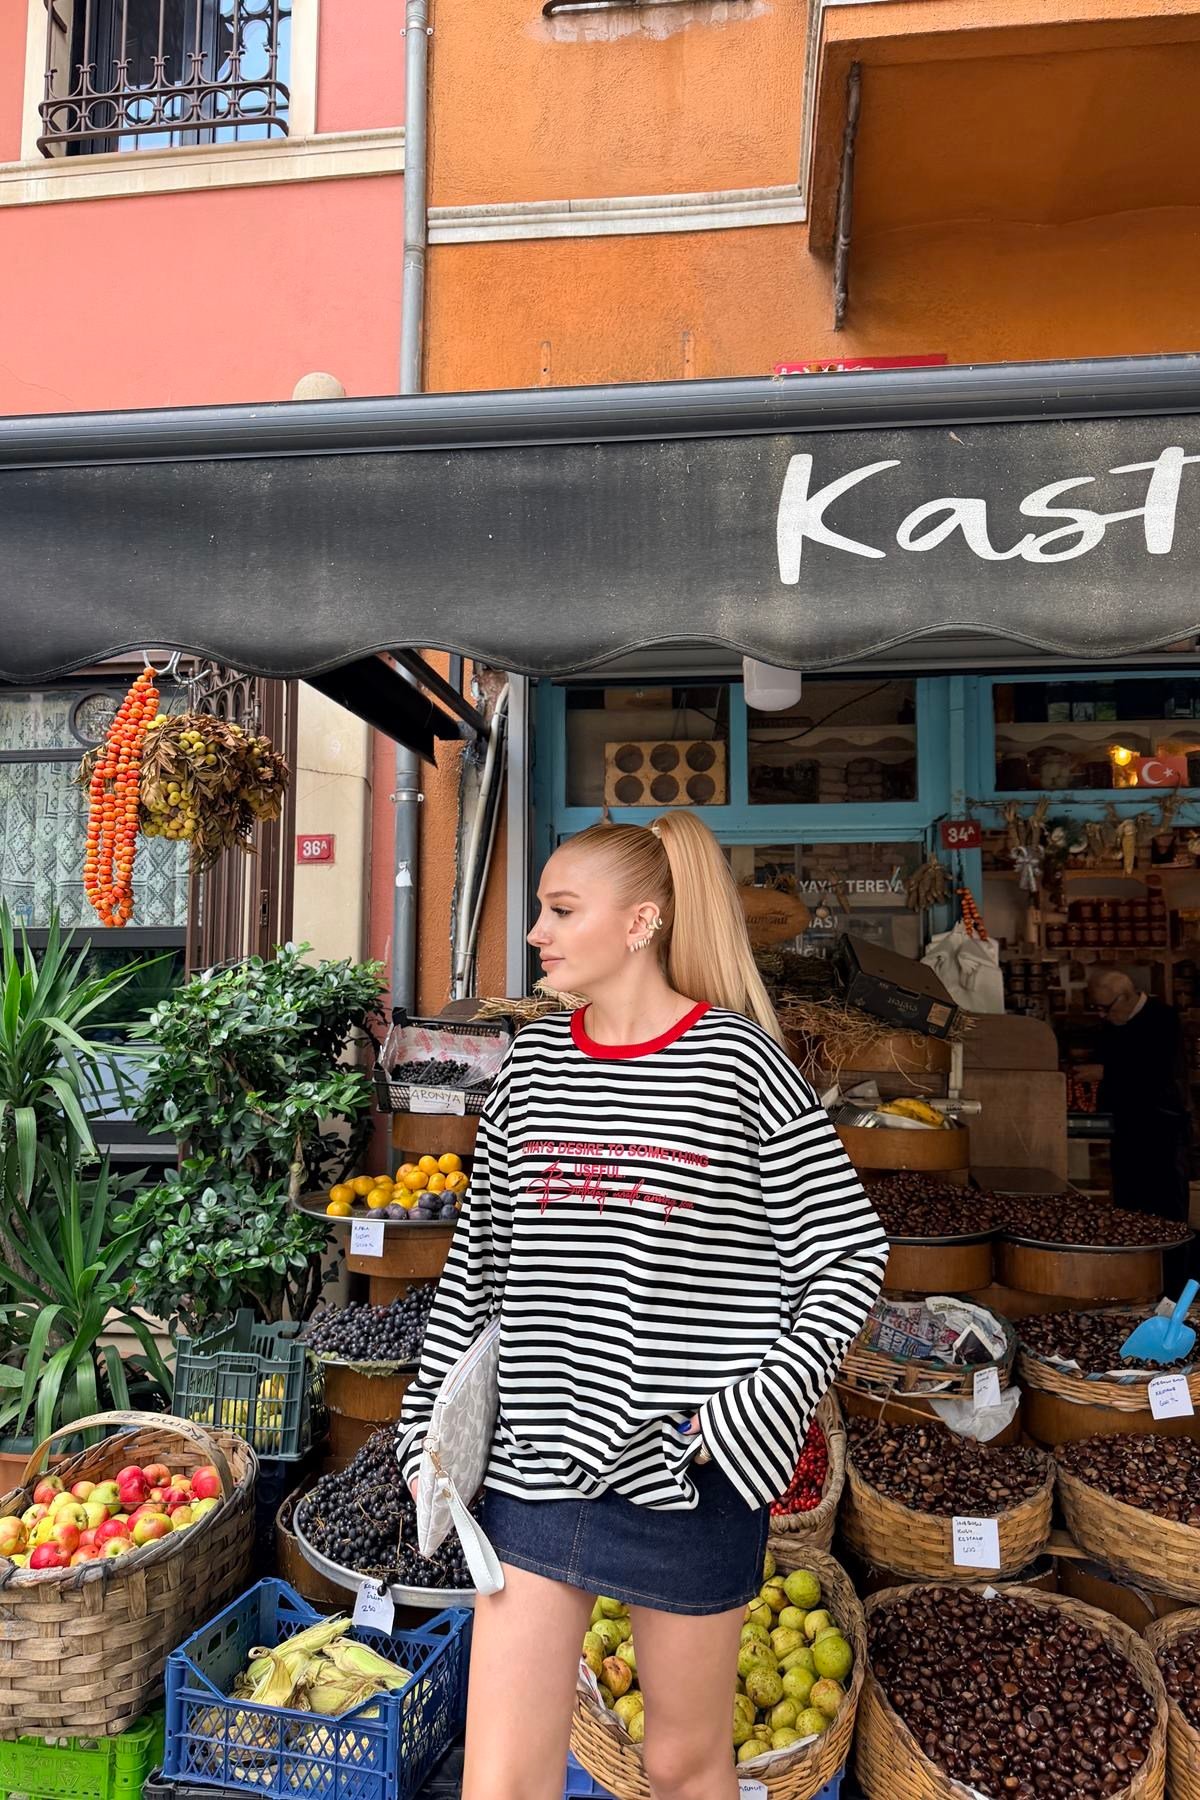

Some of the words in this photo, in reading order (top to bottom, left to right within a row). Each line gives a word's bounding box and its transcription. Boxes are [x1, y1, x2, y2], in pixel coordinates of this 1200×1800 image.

[303, 840, 327, 857] 36A
[411, 1088, 461, 1104] ARONYA
[557, 1142, 604, 1156] DESIRE
[607, 1144, 625, 1156] TO
[628, 1146, 710, 1167] SOMETHING
